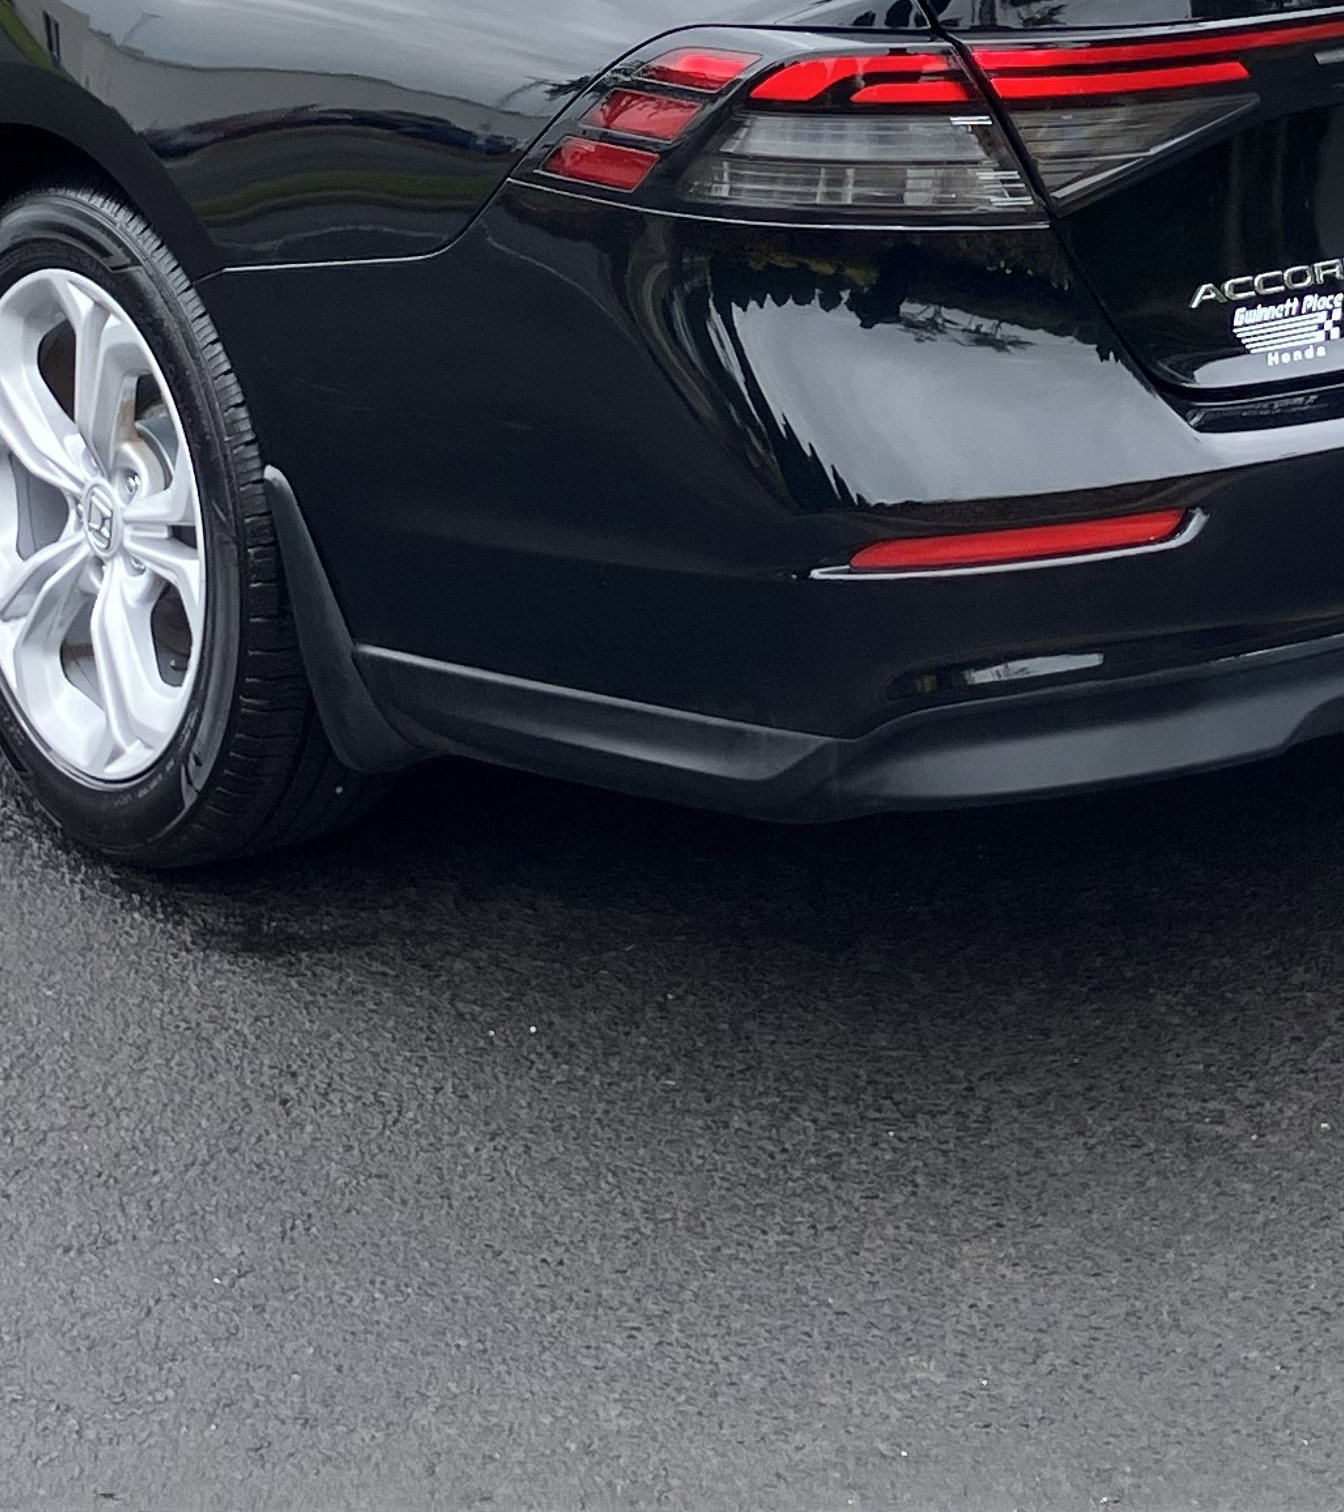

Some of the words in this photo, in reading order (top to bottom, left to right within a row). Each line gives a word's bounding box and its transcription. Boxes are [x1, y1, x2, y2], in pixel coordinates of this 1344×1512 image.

[1233, 296, 1299, 326] Gwinnett
[1301, 292, 1344, 314] Place
[1267, 344, 1326, 367] Honda
